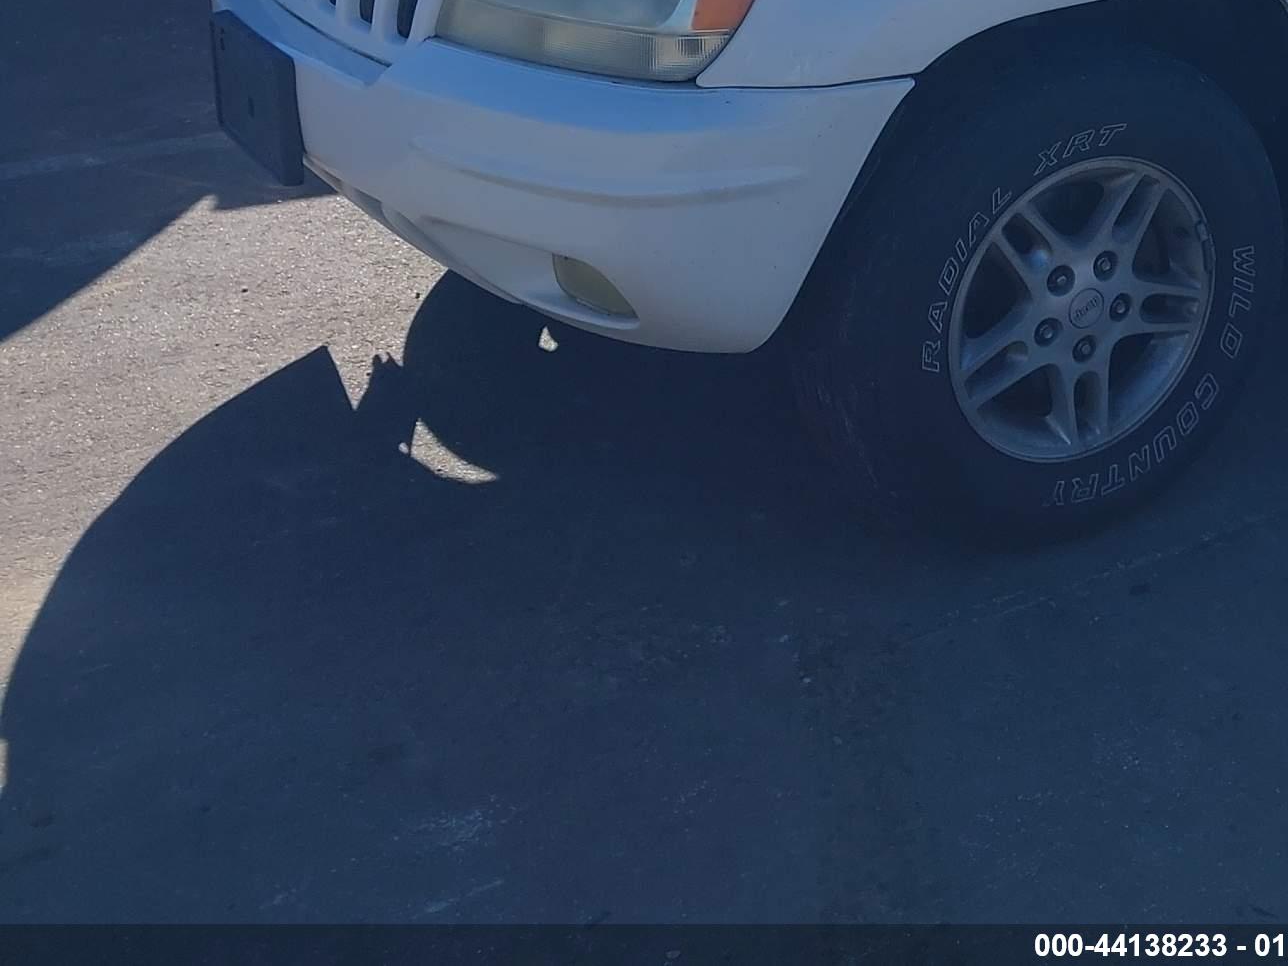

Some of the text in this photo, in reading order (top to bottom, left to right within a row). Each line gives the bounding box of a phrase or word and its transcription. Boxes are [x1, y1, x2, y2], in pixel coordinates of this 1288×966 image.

[921, 123, 1127, 372] RADIAL XRT
[1220, 245, 1255, 358] WILD
